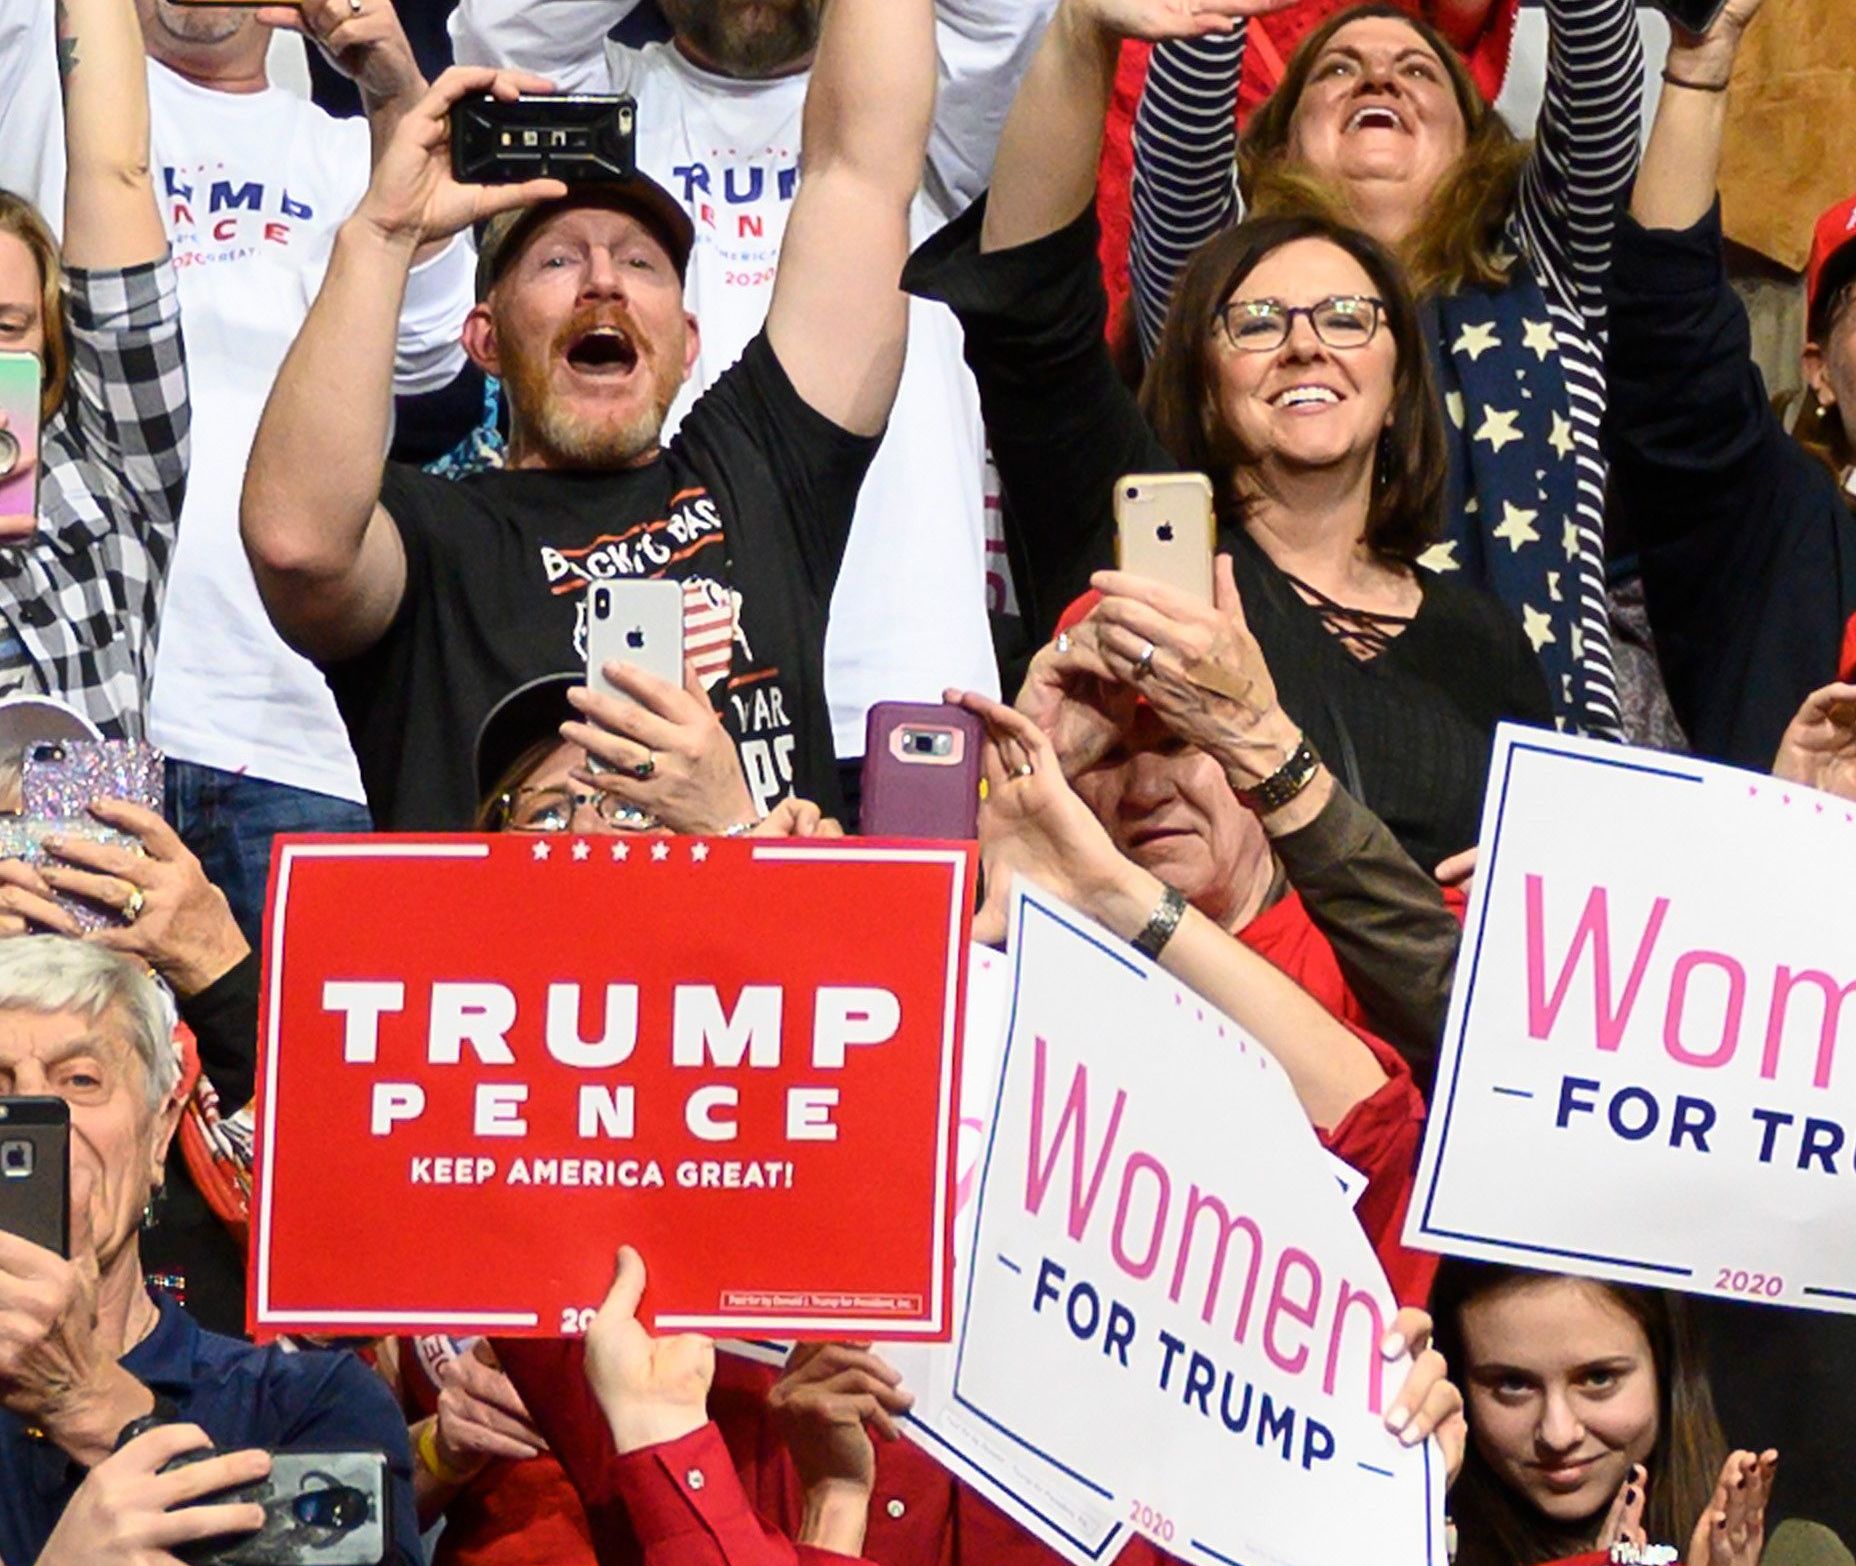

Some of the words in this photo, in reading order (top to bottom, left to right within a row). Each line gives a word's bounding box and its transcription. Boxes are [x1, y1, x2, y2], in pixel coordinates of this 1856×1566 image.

[322, 981, 901, 1068] TRUMP
[371, 1082, 840, 1141] PENCE
[1556, 1075, 1718, 1153] FOR
[411, 1157, 496, 1185] KEEP
[507, 1158, 665, 1188] AMERICA
[676, 1161, 795, 1189] GREAT!
[1024, 1035, 1384, 1416] Women
[1715, 1266, 1784, 1299] 2020
[561, 1308, 596, 1334] 20
[1033, 1256, 1132, 1367] FOR
[1157, 1331, 1337, 1471] TRUMP
[1128, 1499, 1176, 1542] 2020
